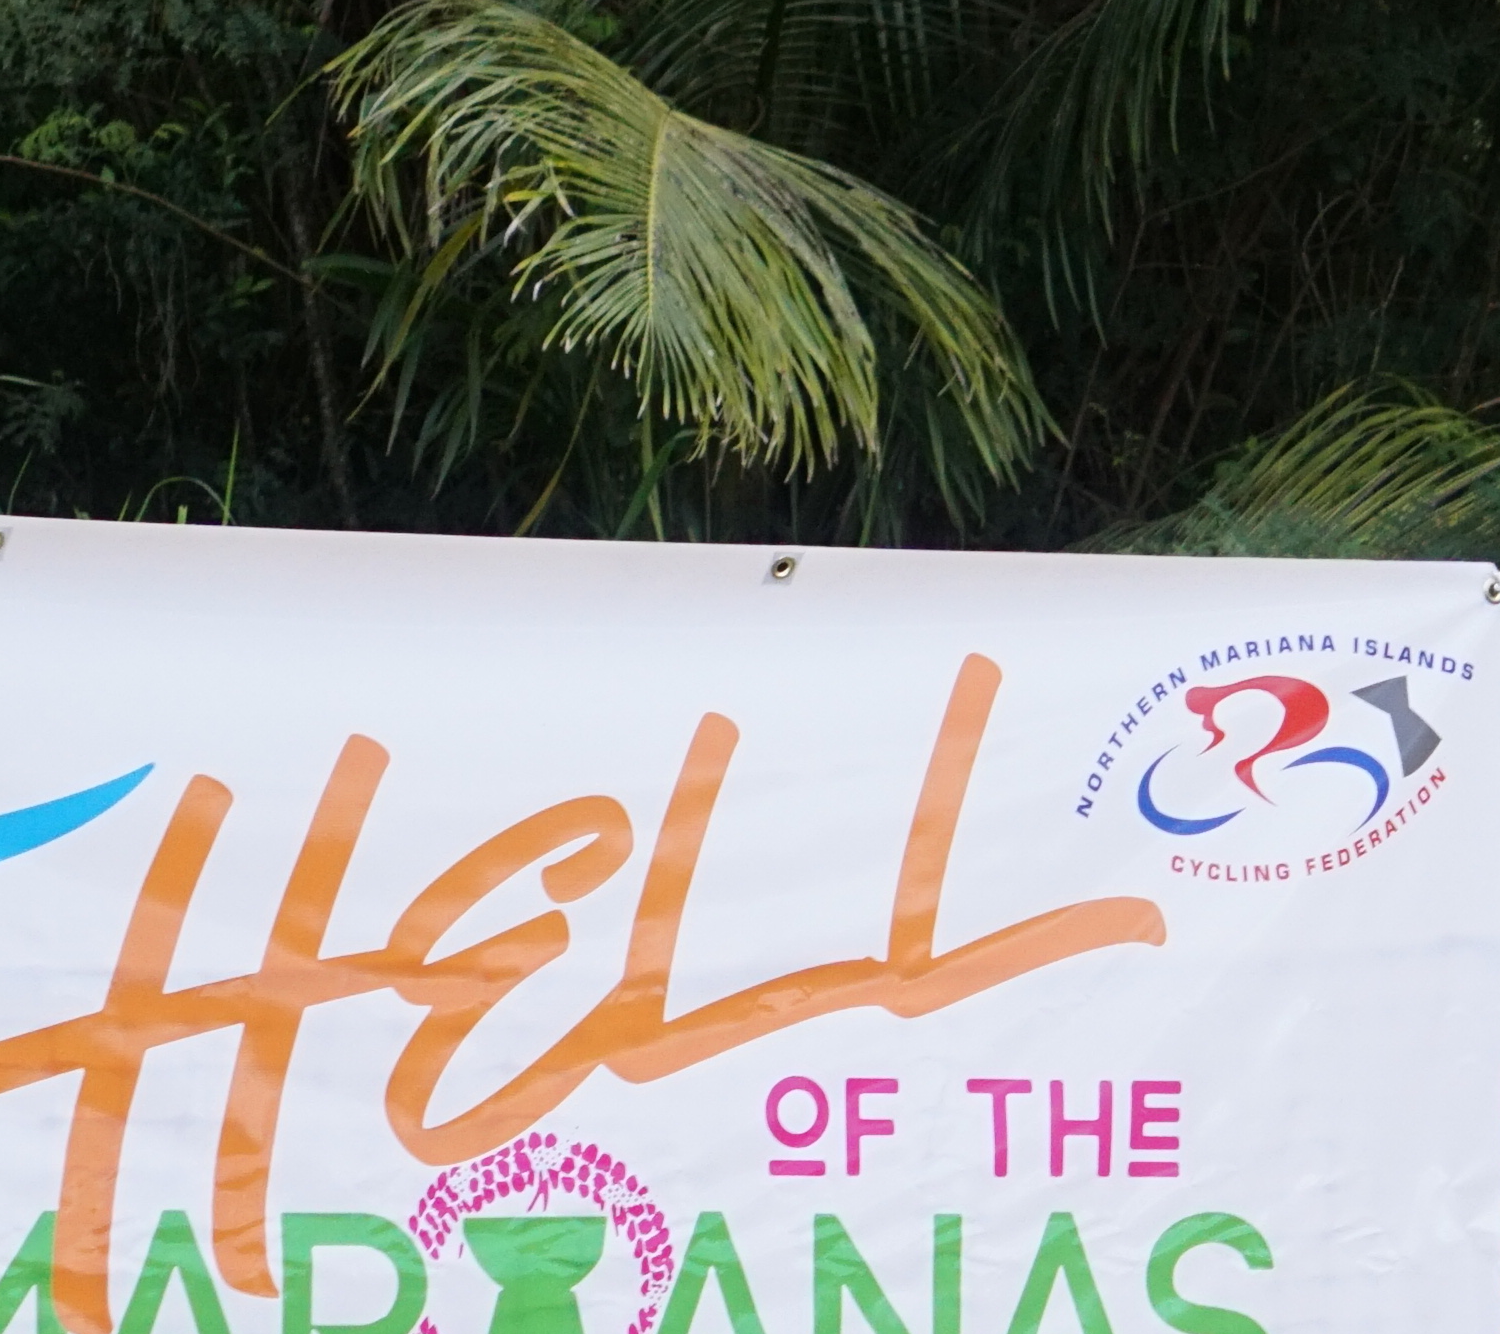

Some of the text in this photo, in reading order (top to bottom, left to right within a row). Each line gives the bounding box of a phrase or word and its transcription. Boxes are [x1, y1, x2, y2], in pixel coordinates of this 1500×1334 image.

[1076, 633, 1475, 819] NORTHERN MARIANA ISLANDS
[1171, 767, 1447, 883] CYCLING FEDERATION
[765, 1075, 1182, 1178] OF THE
